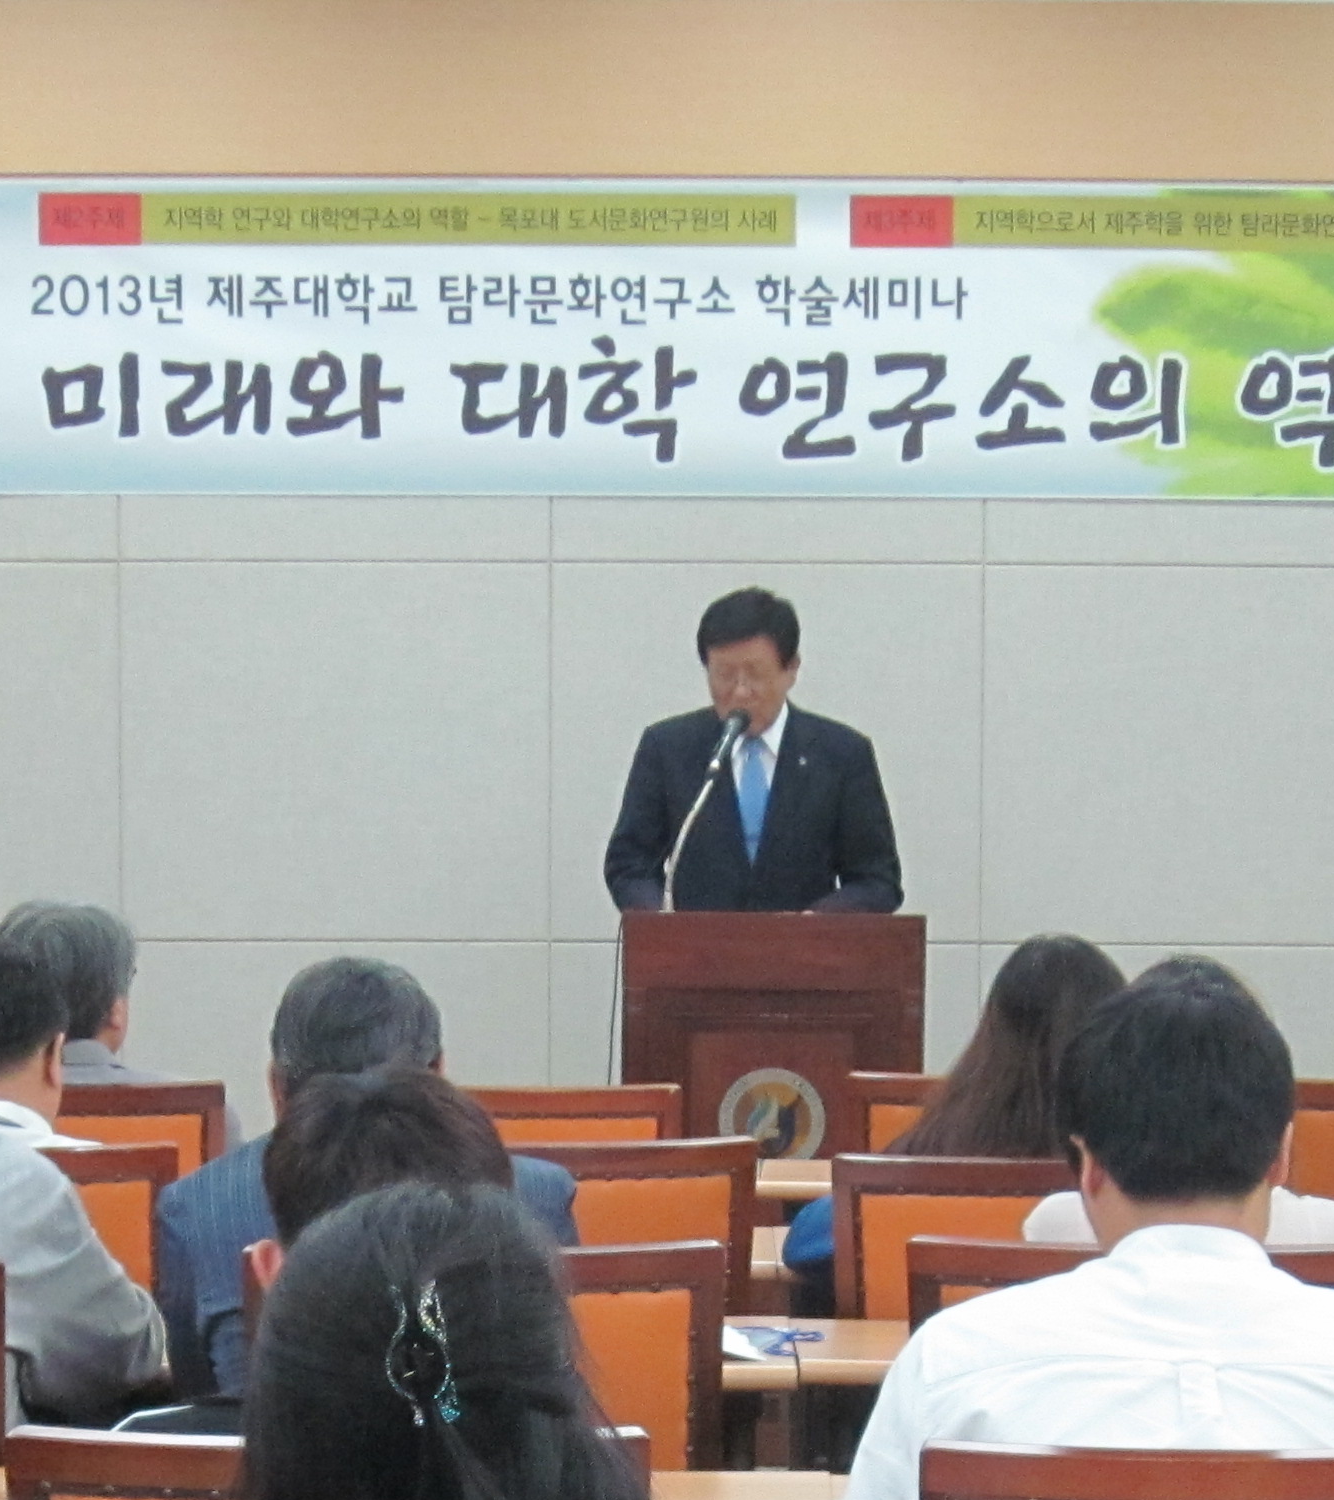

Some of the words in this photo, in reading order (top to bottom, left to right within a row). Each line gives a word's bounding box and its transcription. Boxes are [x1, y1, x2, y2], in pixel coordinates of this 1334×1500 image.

[164, 206, 225, 232] 지역학
[232, 206, 293, 232] 연구와
[300, 205, 423, 231] 대학연구소의
[429, 206, 470, 233] 역할
[499, 206, 560, 233] 목포대
[568, 206, 730, 234] 도서문화연구원의
[737, 207, 778, 233] 사례
[975, 208, 1097, 235] 지역학으로서
[1103, 208, 1185, 237] 제주학을
[1192, 209, 1234, 237] 위한
[31, 273, 184, 324] 2013년
[207, 274, 417, 323] 제주대학교
[437, 274, 737, 325] 탐라문화연구소
[754, 275, 970, 326] 학술세미나
[41, 350, 405, 440] 미래와
[449, 334, 697, 462] 대학
[737, 350, 1181, 465] 연구소의
